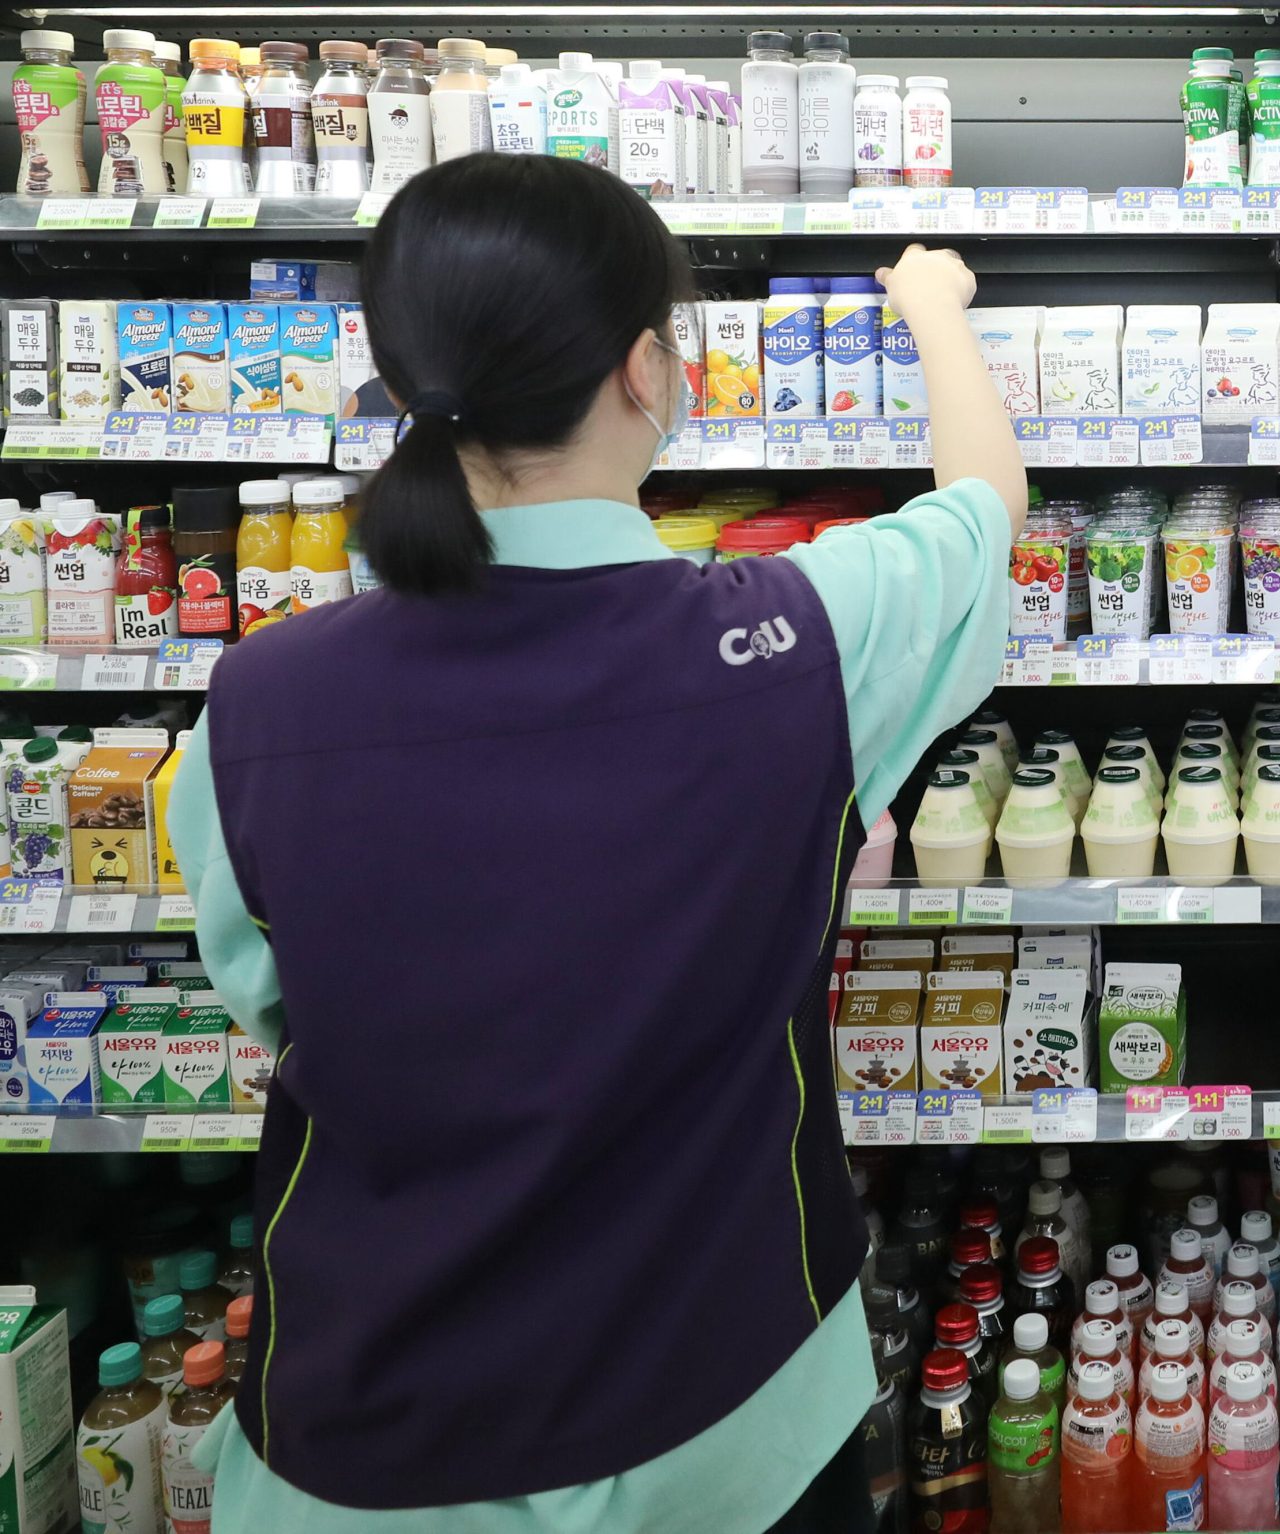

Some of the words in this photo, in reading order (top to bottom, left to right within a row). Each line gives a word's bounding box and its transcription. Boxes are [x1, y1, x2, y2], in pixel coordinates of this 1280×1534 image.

[752, 96, 788, 117] 어른
[497, 124, 519, 137] 초유
[635, 118, 665, 135] 단백
[753, 119, 788, 136] 우유
[856, 119, 887, 138] 쾌변
[911, 117, 944, 137] 쾌변
[630, 143, 659, 158] 20g
[980, 191, 1004, 204] 2+1
[1184, 191, 1206, 204] 2+1
[18, 323, 39, 336] 매일
[74, 325, 94, 339] 매일
[122, 321, 166, 336] Almond
[177, 323, 221, 338] Almond
[232, 322, 277, 338] Almond
[284, 322, 328, 337] Almond
[717, 323, 744, 339] 썬업
[18, 338, 39, 350] 두유
[74, 340, 95, 352] 두유
[131, 332, 160, 346] Breeze
[186, 333, 214, 346] Breeze
[241, 333, 270, 346] Breeze
[293, 332, 322, 346] Breeze
[765, 335, 811, 351] 바이오
[825, 335, 871, 351] 바이오
[140, 359, 168, 374] 프로틴
[246, 362, 277, 376] 식이섬유
[172, 417, 196, 431] 2+1
[896, 422, 919, 435] 2+1
[1083, 422, 1106, 435] 2+1
[1257, 421, 1279, 434] 2+1
[341, 425, 364, 439] 2+1
[54, 563, 85, 581] 썬업
[121, 608, 144, 622] I'm
[122, 620, 168, 638] Real
[165, 643, 188, 657] 2+1
[1156, 640, 1178, 653] 2+1
[76, 768, 120, 778] Coffee
[15, 798, 50, 817] 콜드
[850, 1003, 877, 1014] 커피
[933, 1002, 960, 1014] 커피
[1023, 1002, 1070, 1013] 커피속에
[104, 1039, 157, 1051] 서울우유
[166, 1040, 219, 1054] 서울우유
[847, 1038, 904, 1052] 서울우유
[931, 1038, 988, 1052] 서울우유
[1114, 1041, 1161, 1056] 새싹보리
[40, 1050, 72, 1061] 저지방
[924, 1096, 947, 1109] 2+1
[1132, 1094, 1155, 1108] 1+1
[1195, 1093, 1217, 1107] 1+1
